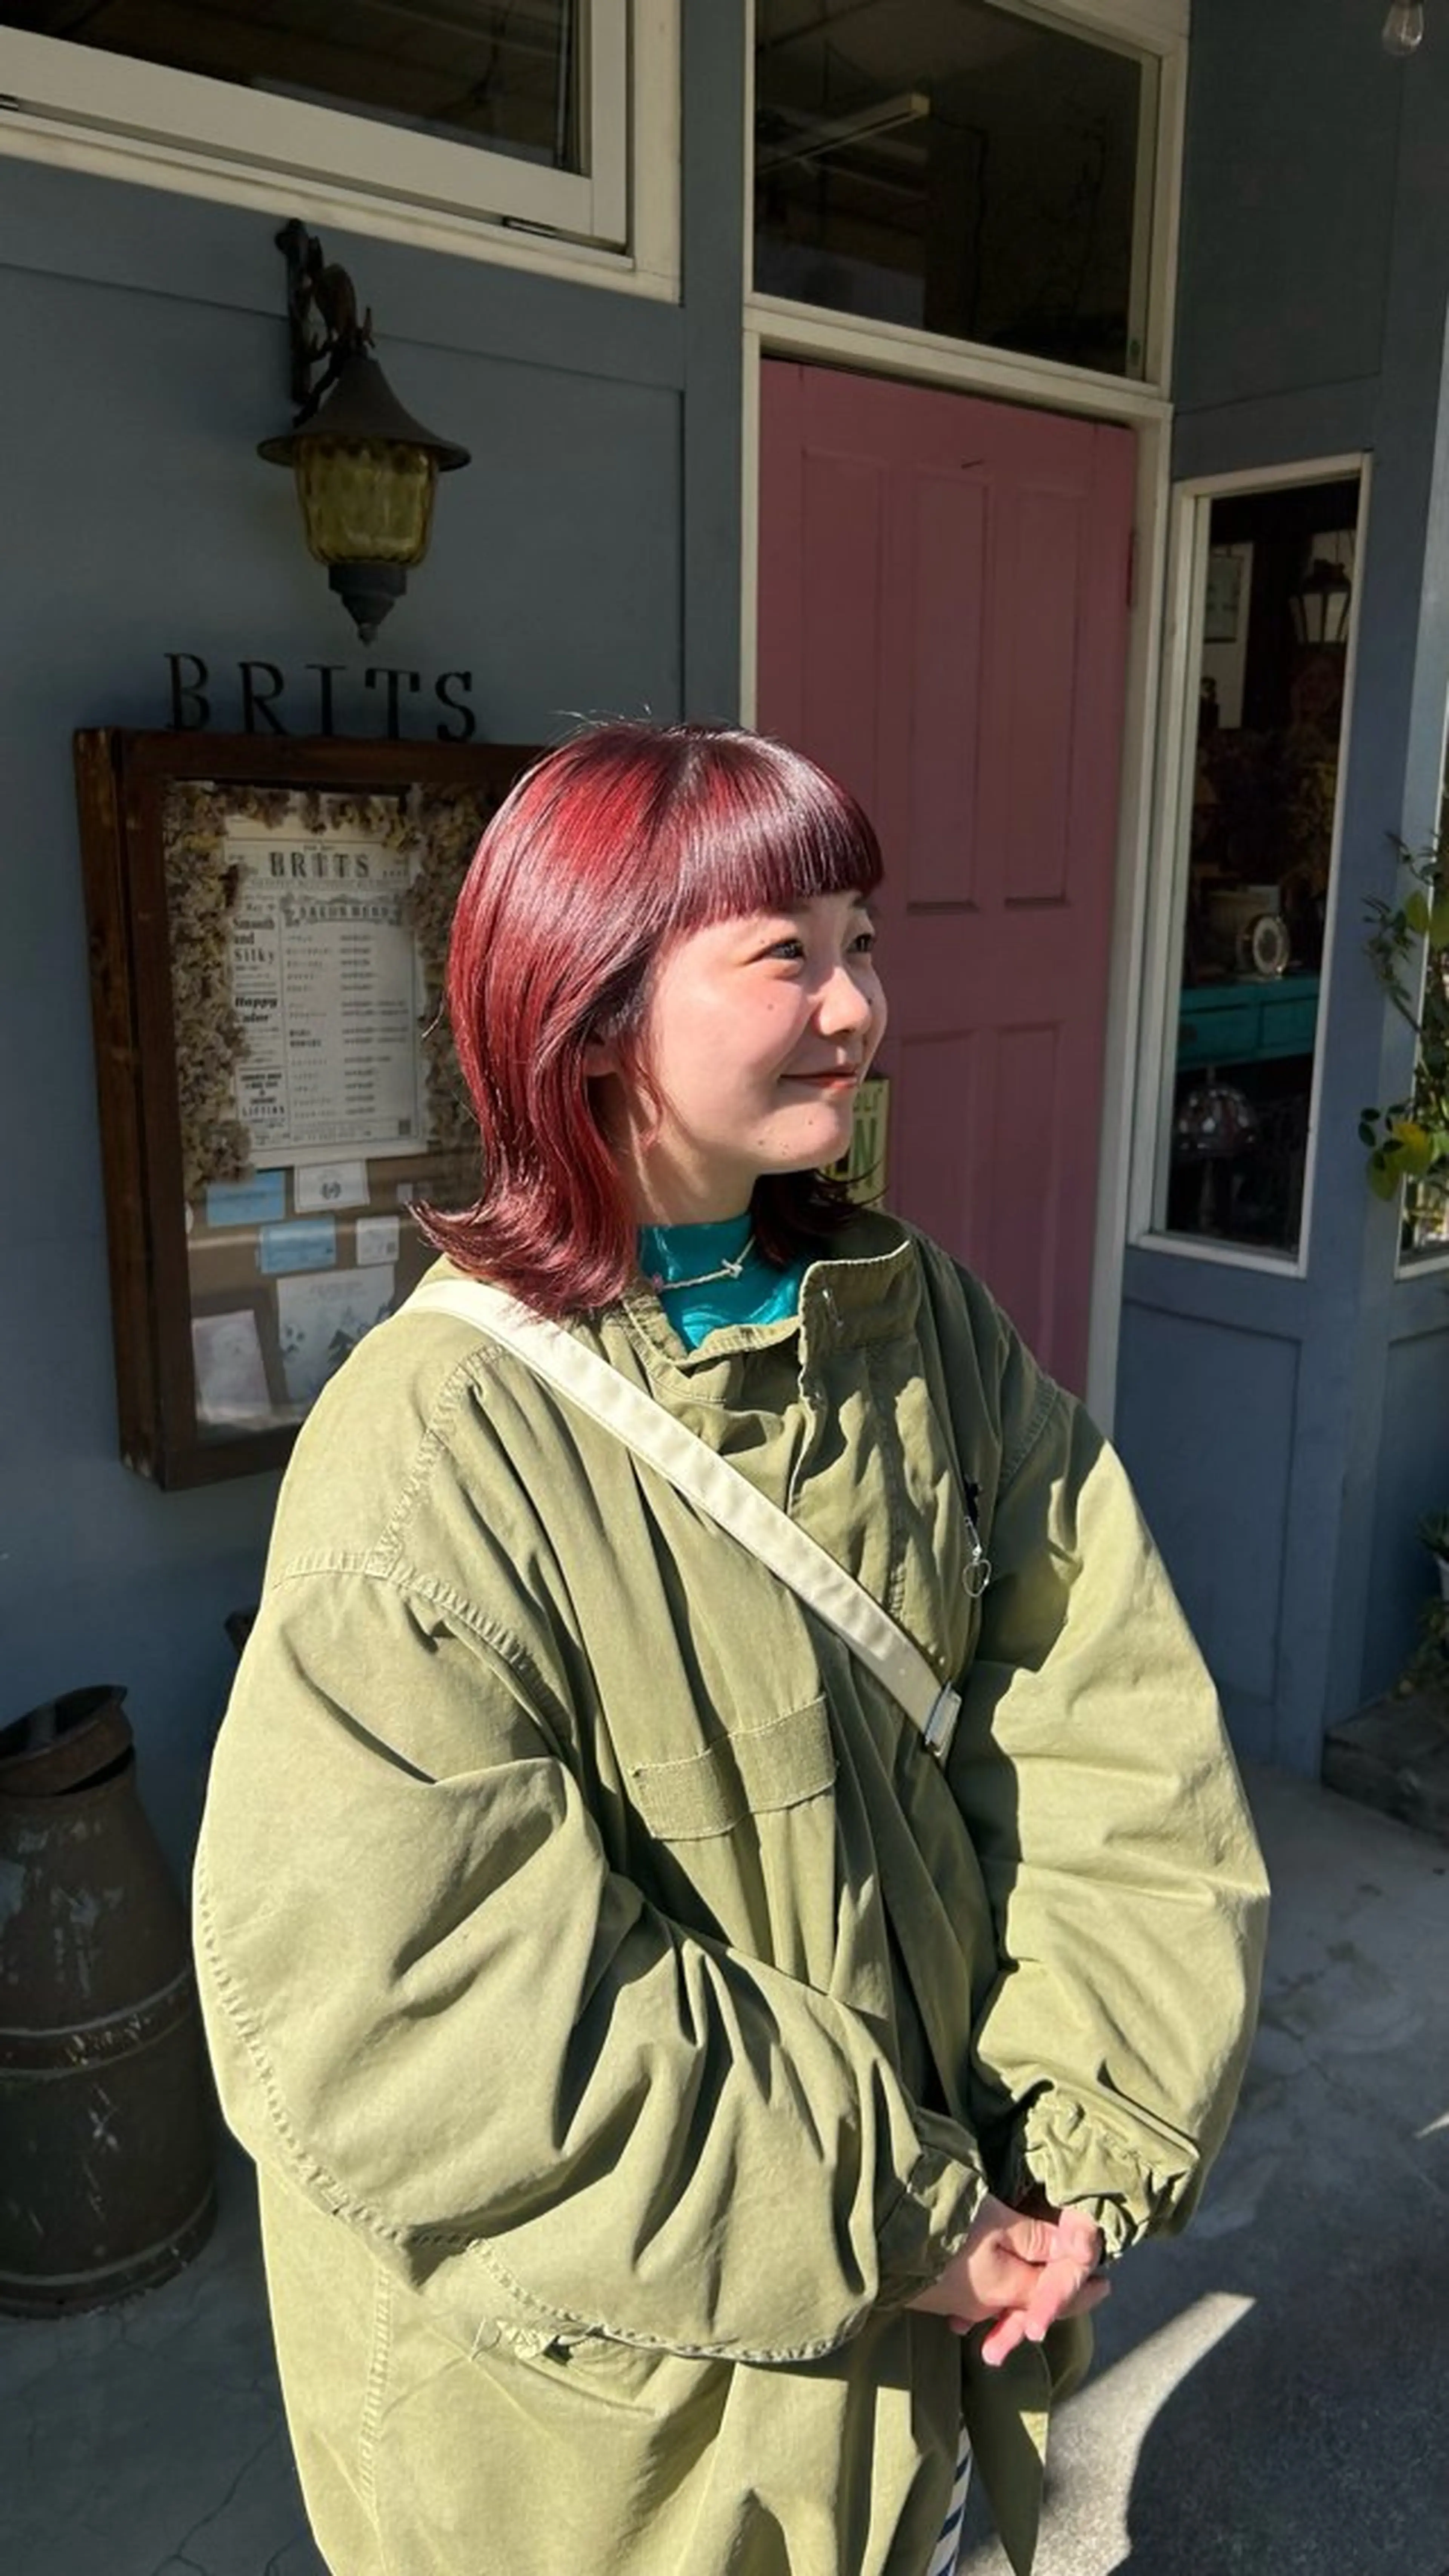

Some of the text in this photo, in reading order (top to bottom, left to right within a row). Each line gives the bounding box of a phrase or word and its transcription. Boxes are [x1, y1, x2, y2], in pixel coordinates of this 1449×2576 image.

[164, 653, 476, 743] BRITS
[268, 852, 370, 878] BRITS
[234, 947, 274, 964] Silky
[235, 997, 278, 1009] Happy
